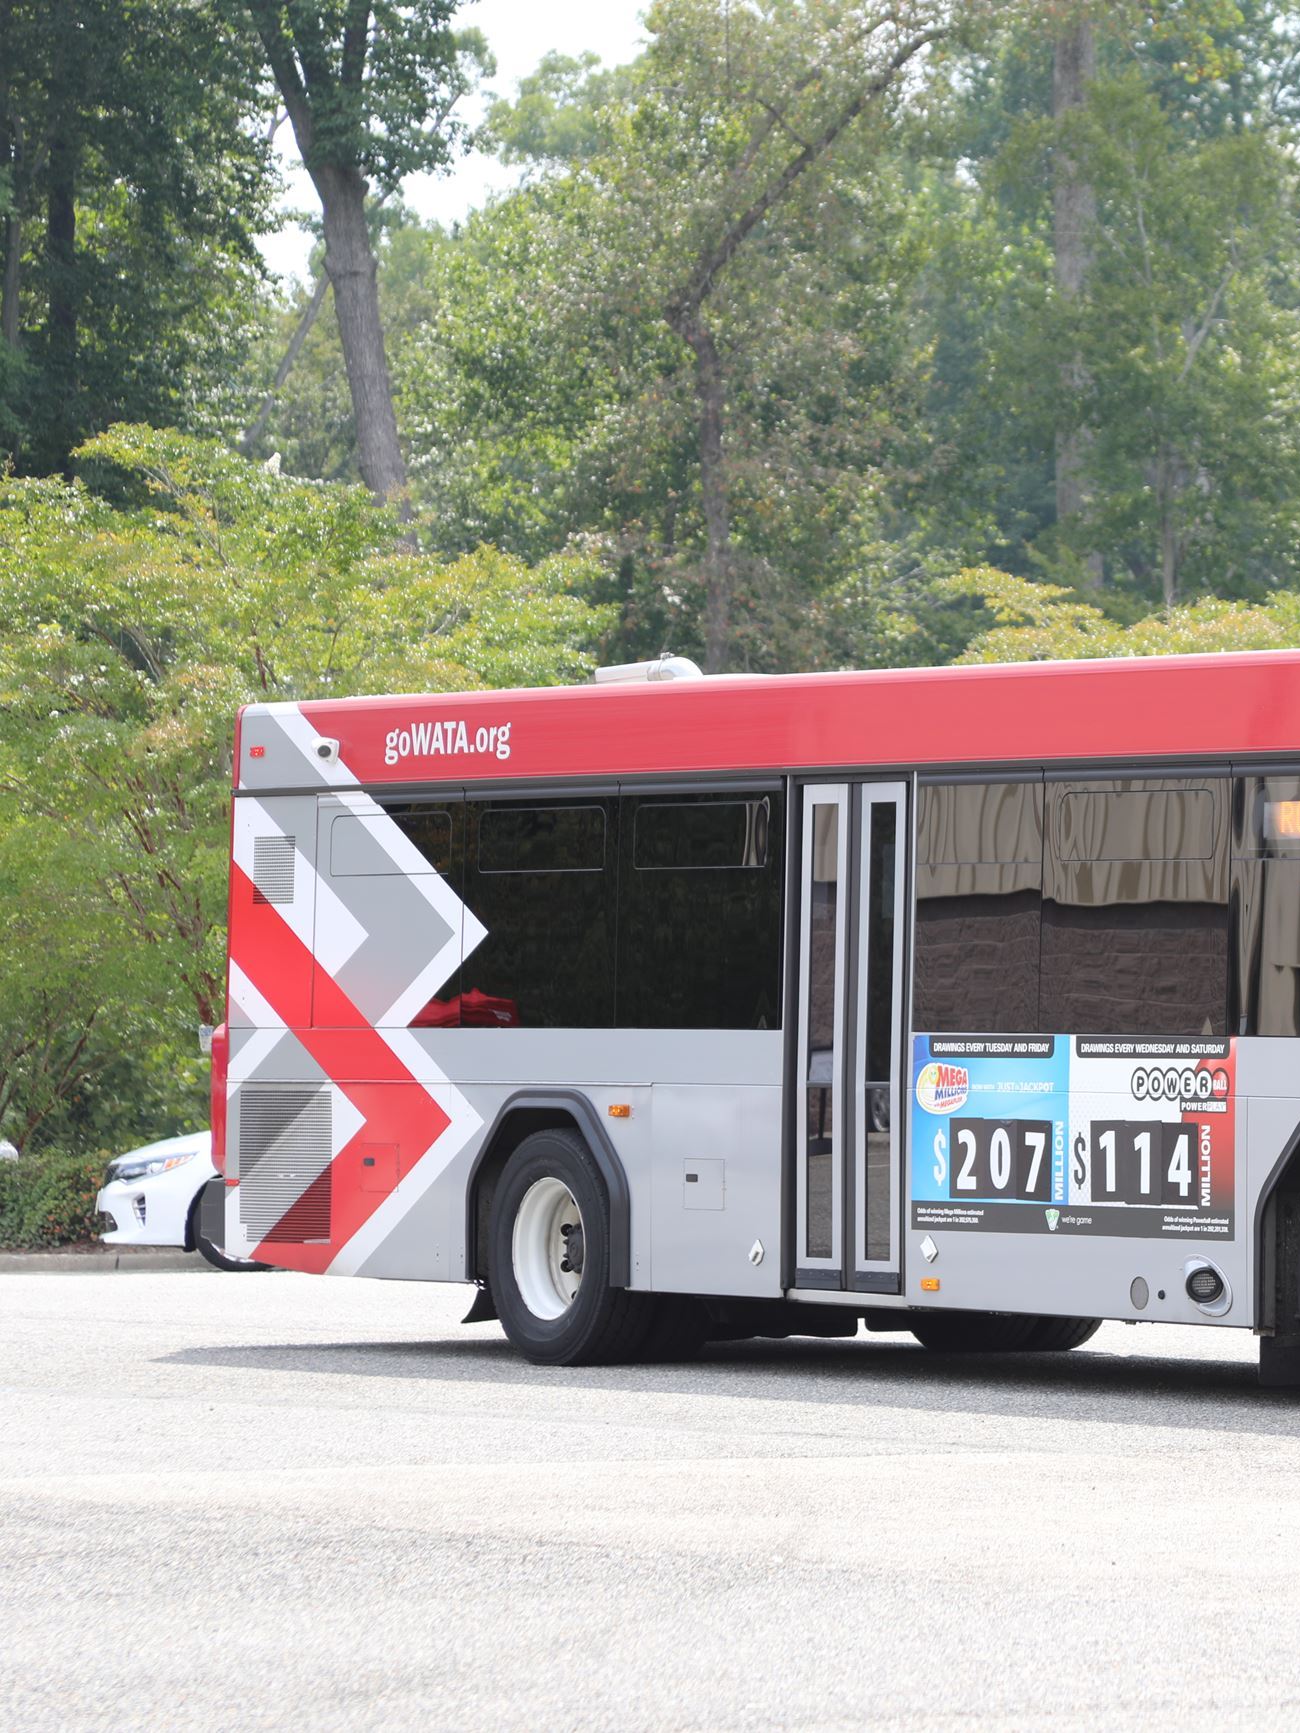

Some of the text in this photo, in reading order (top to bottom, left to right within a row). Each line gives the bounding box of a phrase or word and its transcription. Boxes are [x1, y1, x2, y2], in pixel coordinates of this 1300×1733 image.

[384, 720, 512, 765] goWATA.org
[933, 1043, 1050, 1053] DRAWINGS EVERY TUESDAY AND FRIDAY
[1081, 1043, 1225, 1054] DRAWINGS EVERY WEDNESDAY AND SATURDAY
[936, 1064, 968, 1088] MEGA
[1055, 1121, 1064, 1200] MILLION
[1201, 1125, 1211, 1206] MILLION
[1076, 1217, 1092, 1225] game
